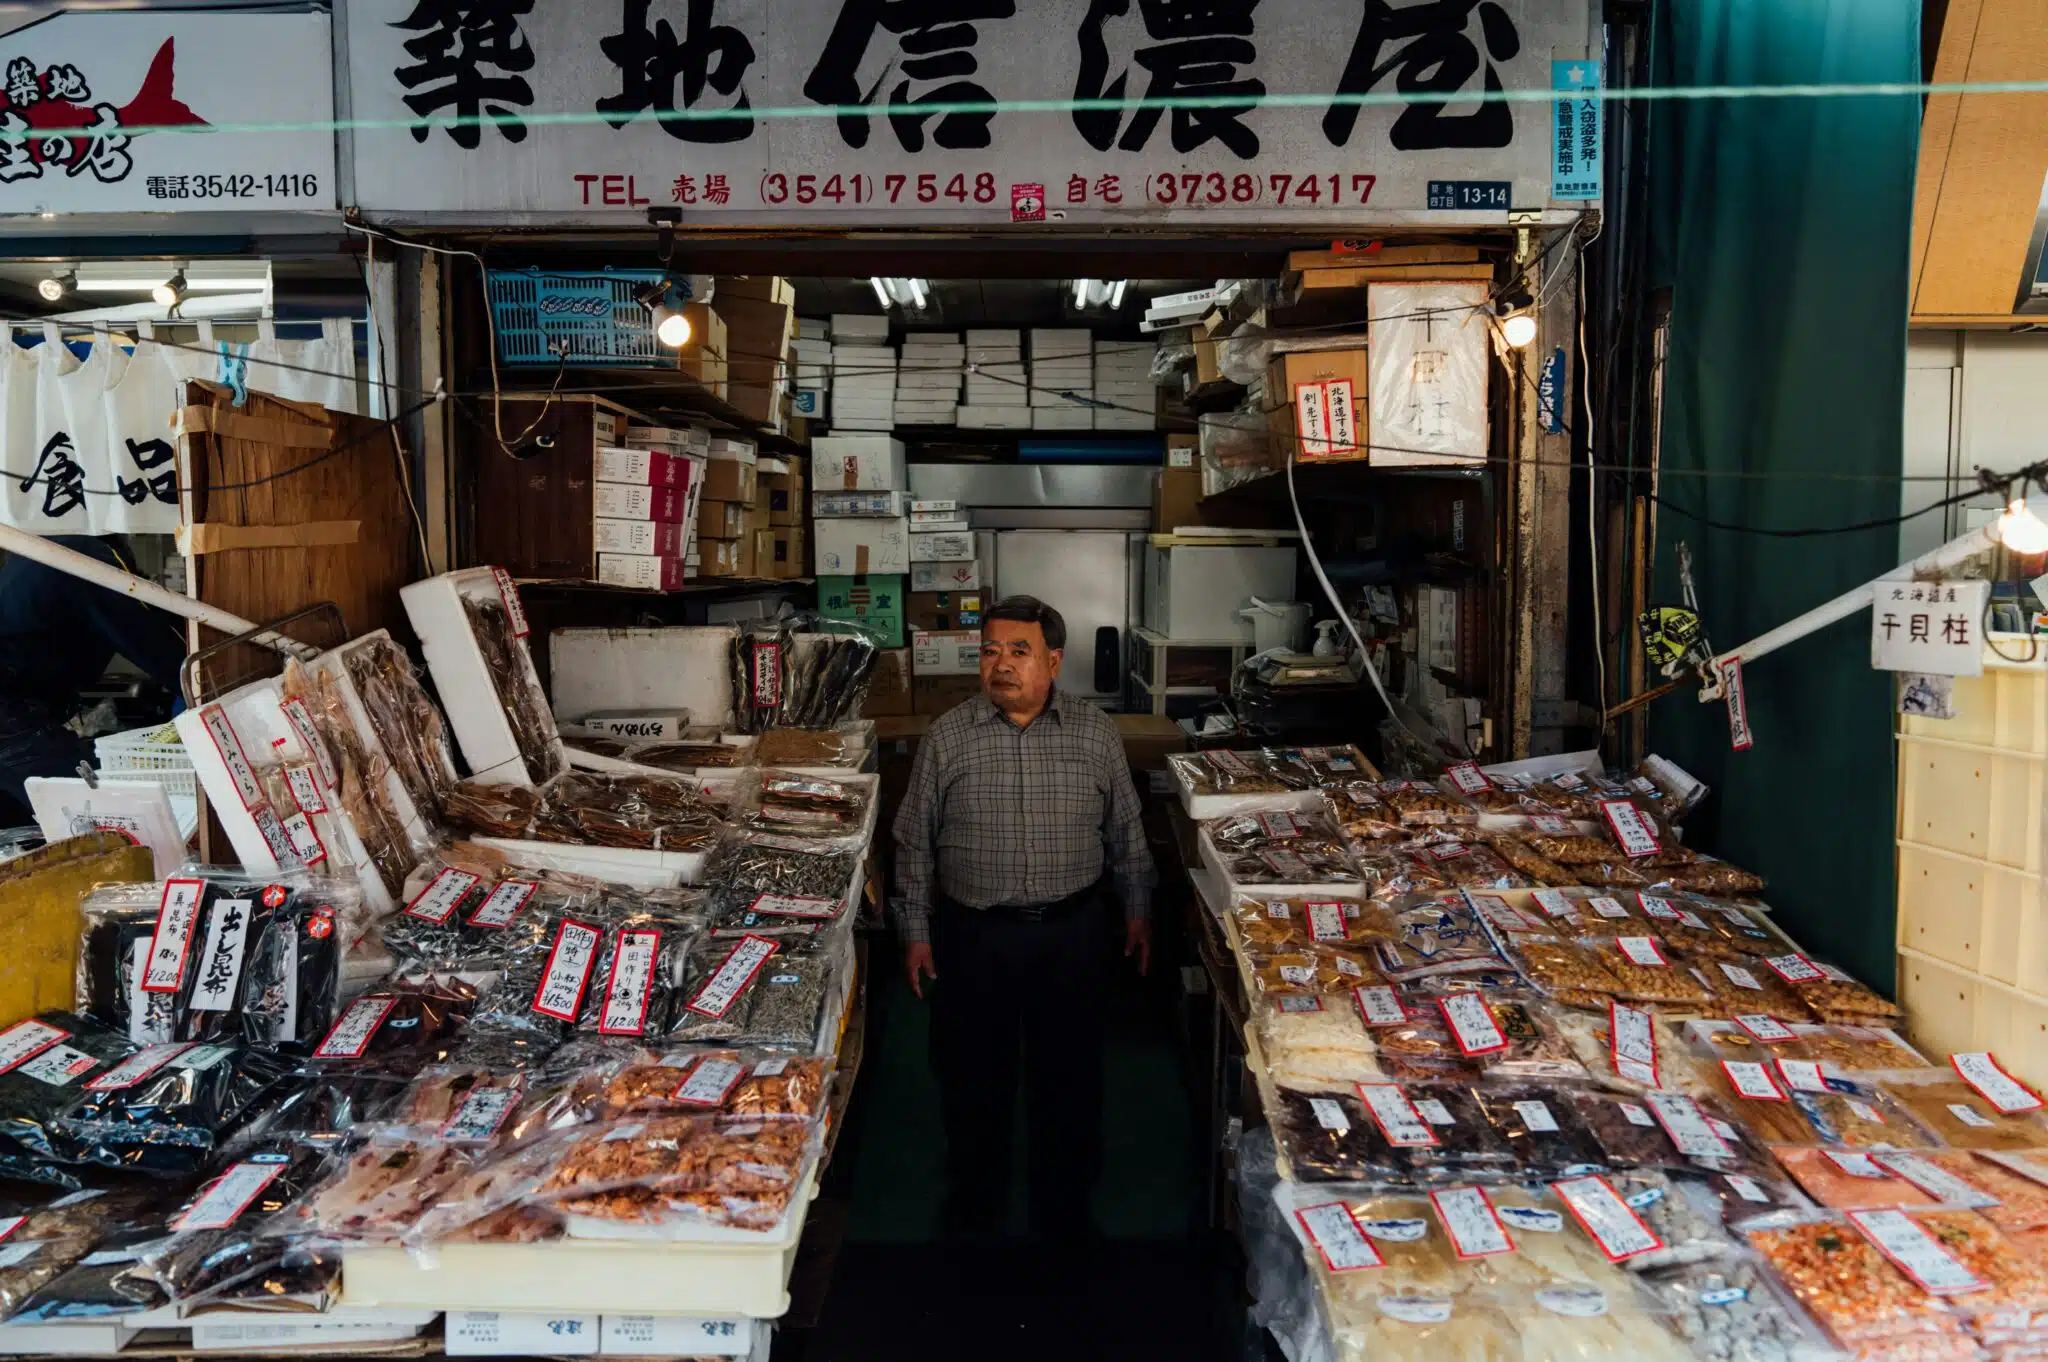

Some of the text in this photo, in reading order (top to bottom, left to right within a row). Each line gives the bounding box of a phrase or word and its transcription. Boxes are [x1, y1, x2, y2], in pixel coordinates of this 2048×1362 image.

[6, 56, 92, 108] 築地
[384, 0, 1520, 160] 築地信濃屋
[574, 174, 650, 205] TEL
[671, 174, 730, 205] 売場
[1066, 173, 1123, 204] 自宅
[1463, 187, 1507, 204] 13-14
[19, 431, 180, 518] 食品
[1881, 613, 1970, 645] 干貝柱
[201, 906, 243, 1004] 出し昆布
